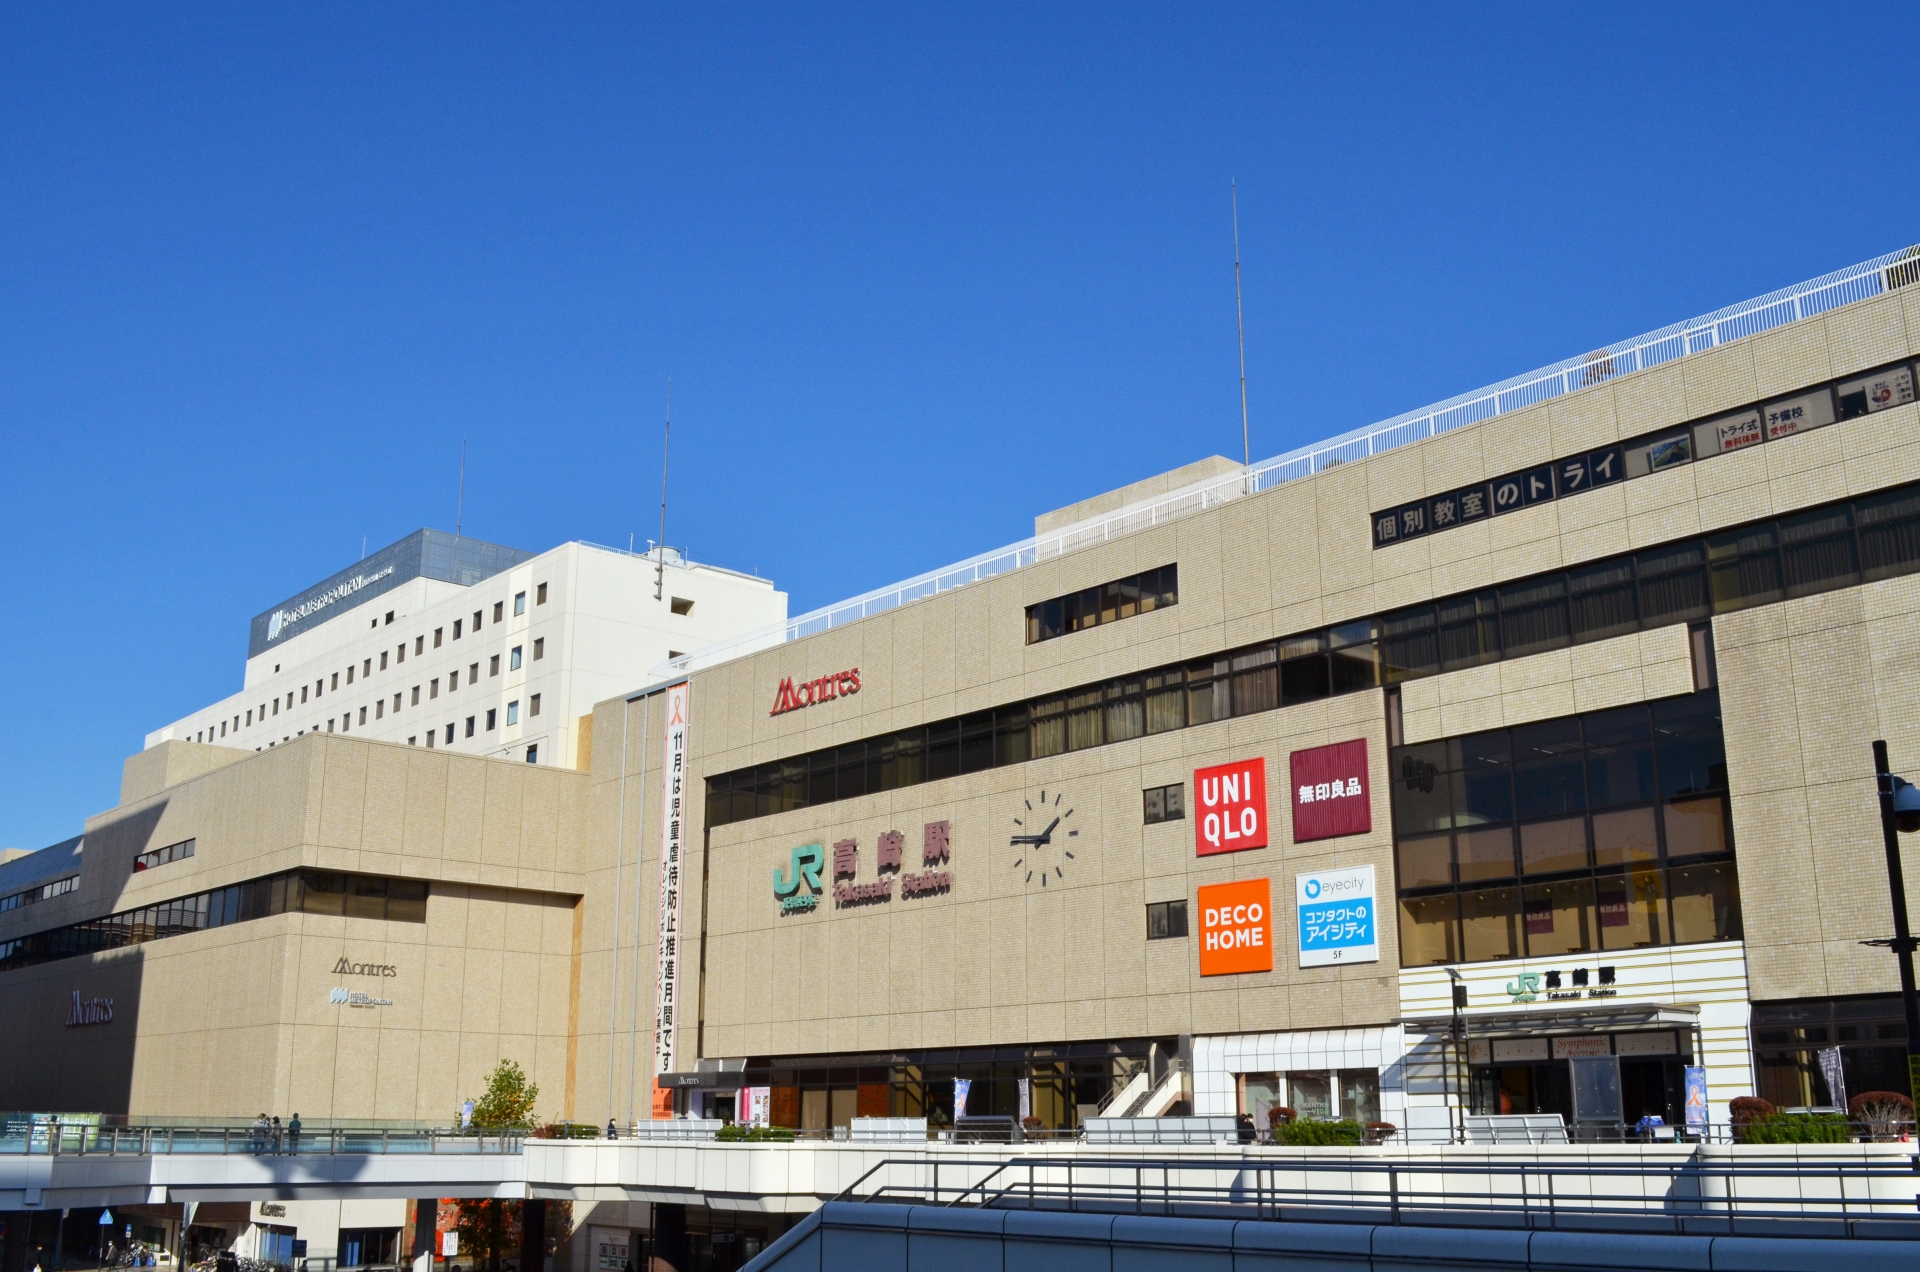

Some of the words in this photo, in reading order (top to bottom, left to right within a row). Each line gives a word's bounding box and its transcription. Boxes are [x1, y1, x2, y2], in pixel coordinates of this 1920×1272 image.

[1720, 419, 1758, 438] トライ式
[1768, 406, 1803, 425] 予備校
[1724, 432, 1760, 449] 無料体験
[1770, 422, 1797, 436] 受付中
[1377, 452, 1615, 541] 個別教室のトライ
[769, 667, 861, 715] Montres
[1202, 771, 1251, 806] UNI
[1299, 777, 1362, 804] 無印良品
[1204, 807, 1257, 846] QLO
[773, 843, 824, 895] JR
[833, 877, 892, 902] Takasaki
[901, 871, 951, 893] Station
[1322, 877, 1365, 894] eyecity
[1205, 903, 1263, 927] DECO
[1305, 906, 1367, 924] コンタクトの
[1206, 927, 1264, 950] HOME
[1306, 922, 1367, 942] アイシティ
[1333, 950, 1343, 959] 5F
[331, 957, 397, 977] Montres
[1507, 972, 1540, 995] JR
[1546, 990, 1581, 1000] Takasaki
[1588, 988, 1617, 998] Station
[1557, 1036, 1607, 1049] Symphonic
